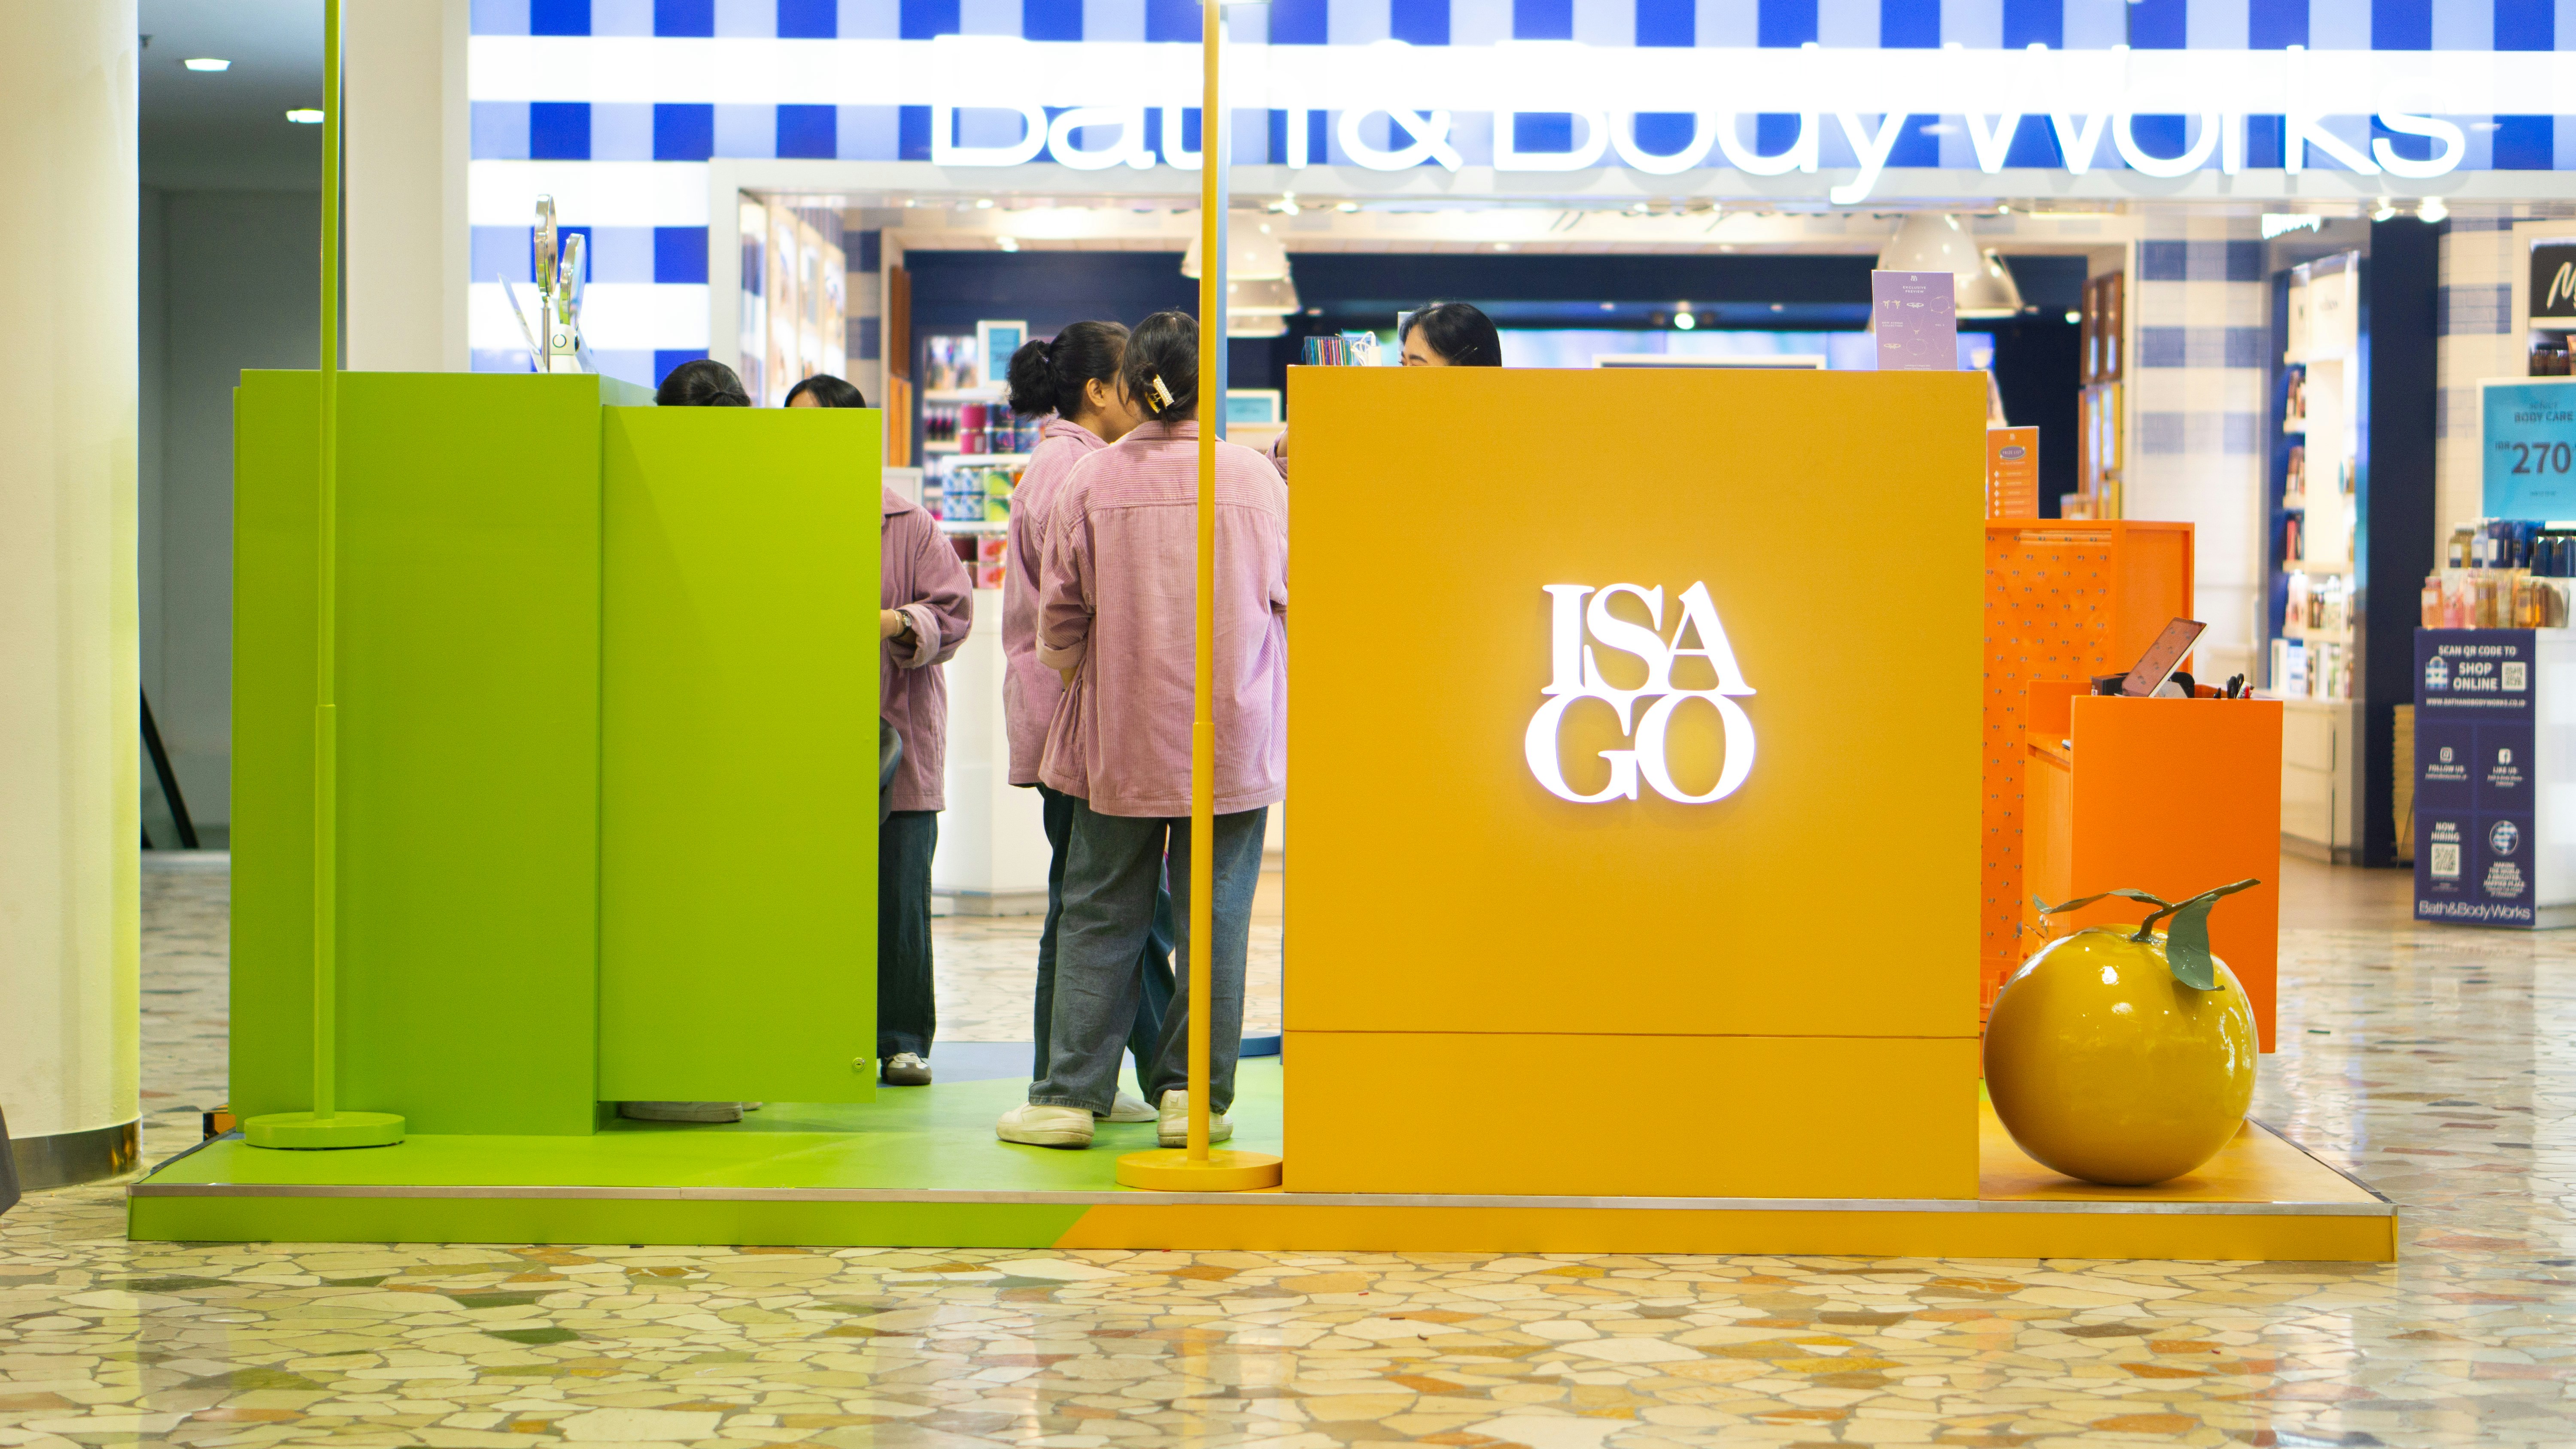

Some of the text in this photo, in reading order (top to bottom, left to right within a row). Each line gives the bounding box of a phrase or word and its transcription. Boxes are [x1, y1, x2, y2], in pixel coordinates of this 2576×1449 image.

[2514, 411, 2574, 422] BODY CARE
[2438, 645, 2517, 658] SCAN QR CODE TO
[2459, 661, 2492, 676] SHOP
[2453, 676, 2498, 691] ONLINE
[2436, 822, 2455, 831] NOW
[2431, 831, 2460, 842] HIRING
